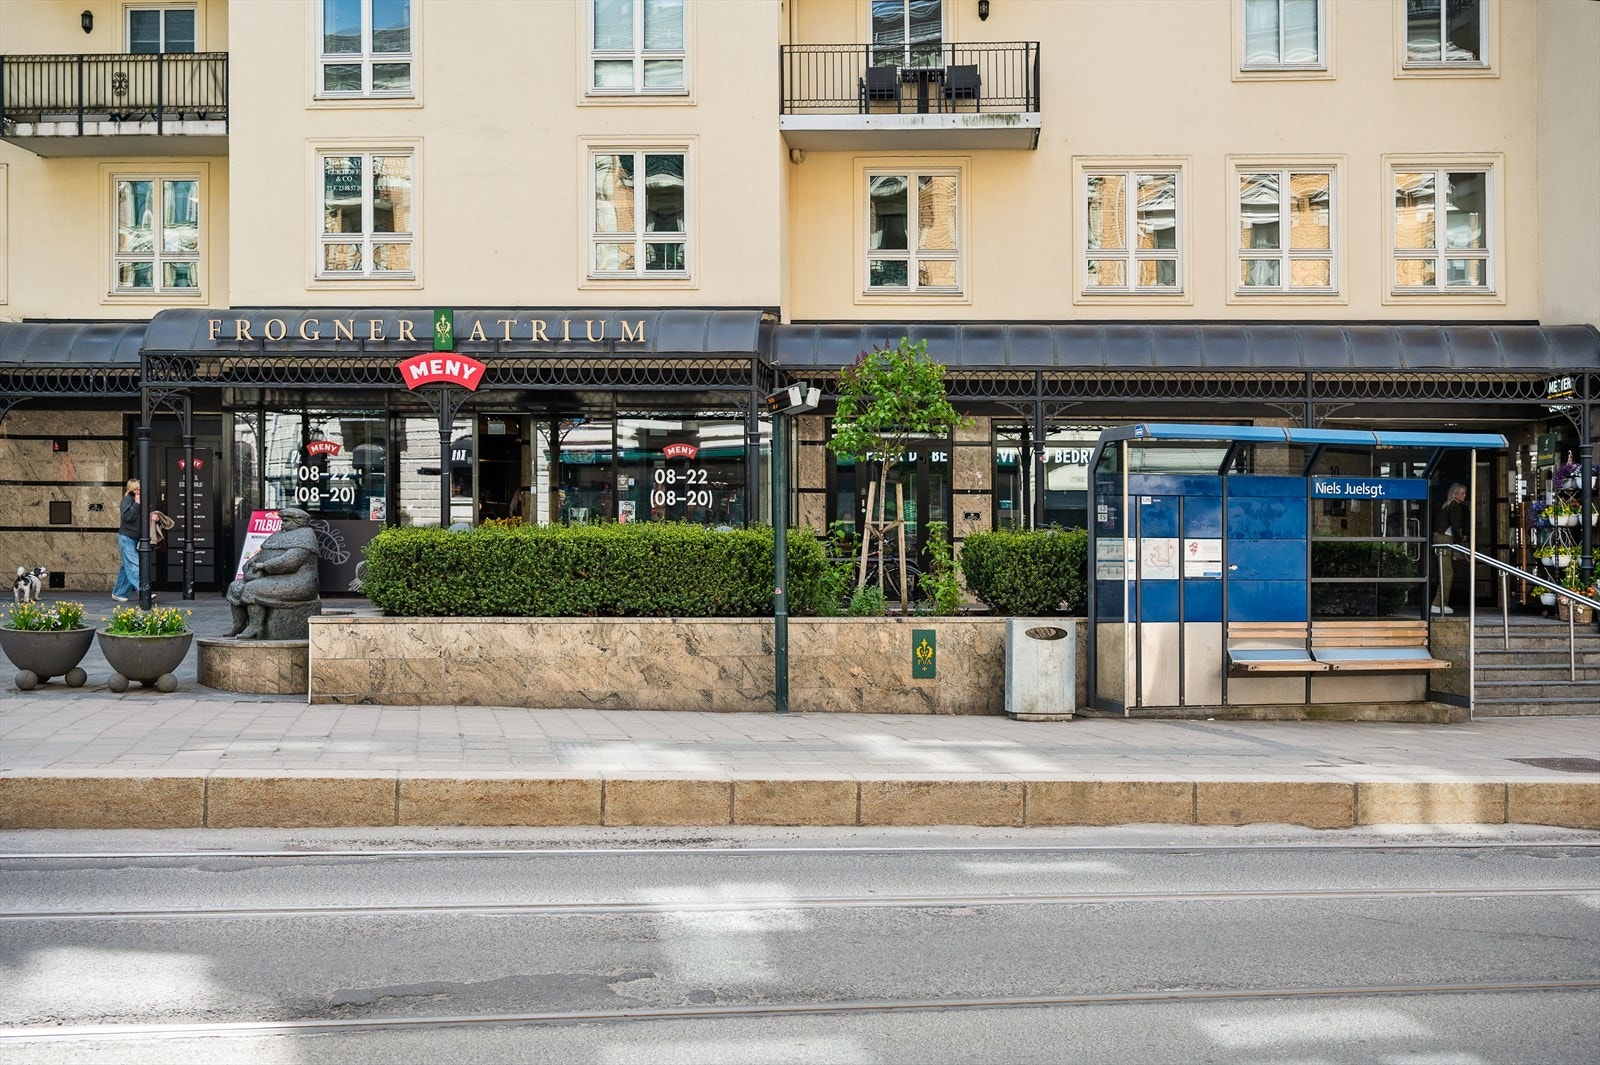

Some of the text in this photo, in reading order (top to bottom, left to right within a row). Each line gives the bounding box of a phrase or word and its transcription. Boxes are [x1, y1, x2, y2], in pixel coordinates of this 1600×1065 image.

[208, 318, 646, 342] FROGNER ATRIUM
[409, 359, 477, 380] MENY
[311, 443, 337, 453] MENY
[667, 446, 694, 455] MENY
[299, 465, 350, 481] 08–22
[654, 469, 708, 484] 08–22
[294, 487, 355, 504] (08–20)
[1315, 482, 1386, 498] Niels Juelsgt.
[650, 489, 713, 508] (08–20)
